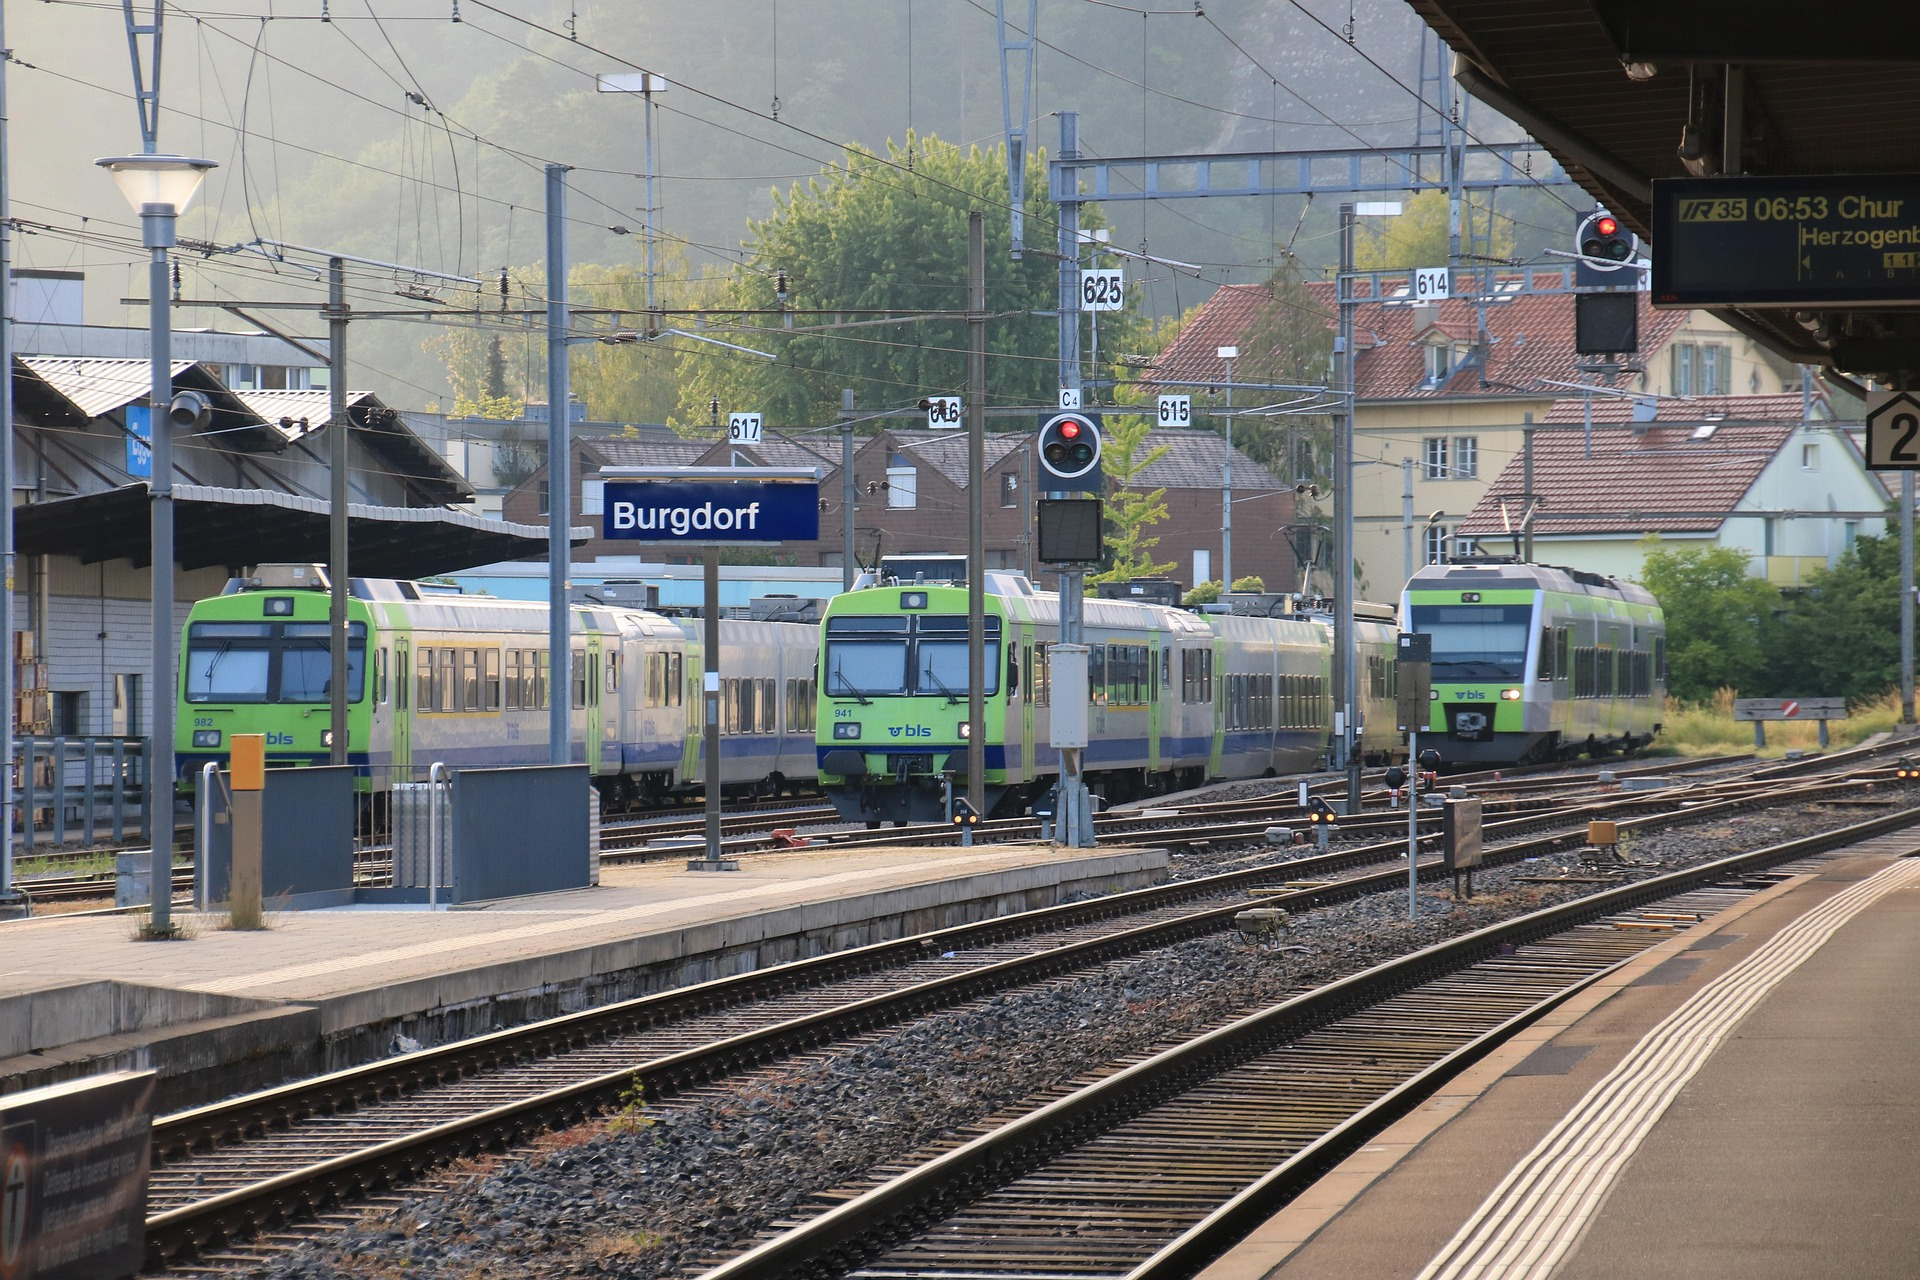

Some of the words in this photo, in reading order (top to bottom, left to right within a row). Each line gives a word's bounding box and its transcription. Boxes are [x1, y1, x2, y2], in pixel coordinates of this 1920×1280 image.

[1717, 201, 1744, 219] 35
[1755, 196, 1828, 220] 06:53
[1839, 196, 1903, 218] Chur
[1418, 273, 1447, 295] 614
[1887, 269, 1895, 279] B
[1083, 275, 1122, 306] 625
[930, 402, 958, 424] 66
[1160, 399, 1189, 421] 615
[731, 418, 759, 439] 617
[1890, 412, 1919, 462] 2
[613, 500, 760, 536] Burgdorf
[1467, 690, 1485, 699] bls
[194, 717, 213, 727] 982
[835, 708, 852, 718] 941
[266, 732, 293, 745] bls
[905, 724, 932, 736] bls
